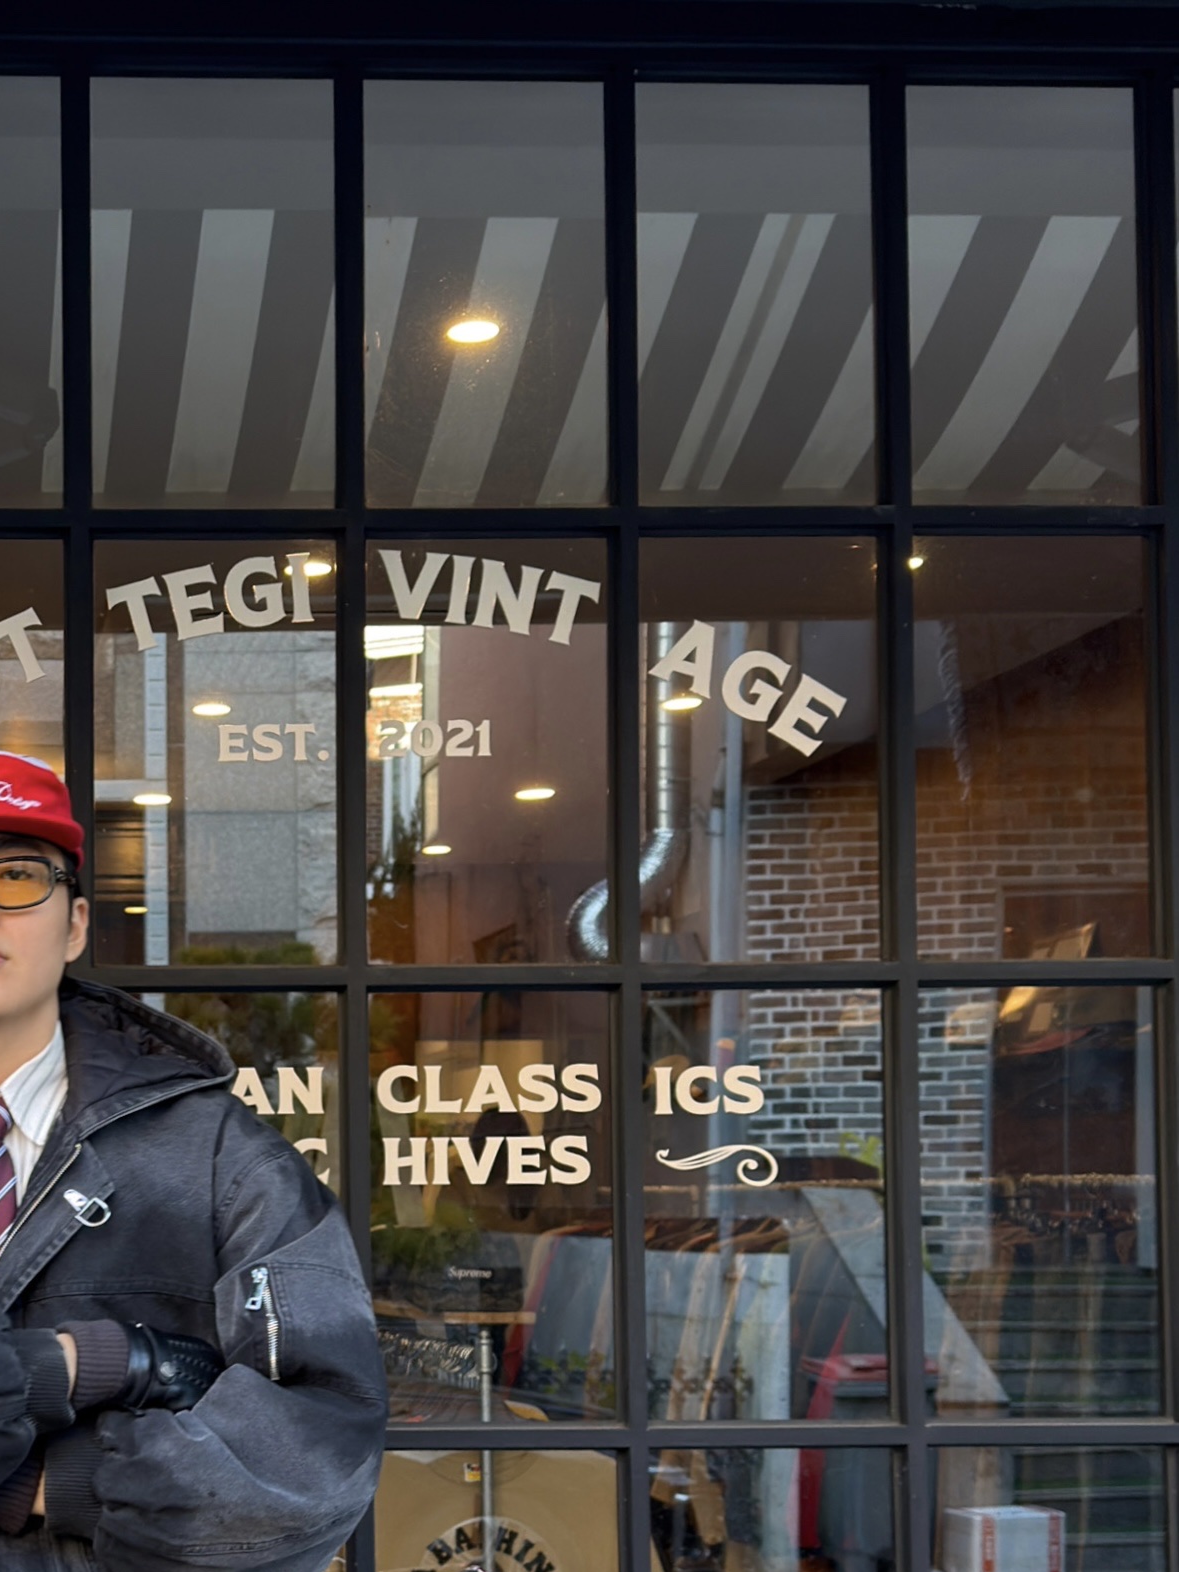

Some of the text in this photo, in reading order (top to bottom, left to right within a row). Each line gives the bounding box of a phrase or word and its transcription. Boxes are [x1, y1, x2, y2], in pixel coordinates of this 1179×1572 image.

[106, 552, 315, 651] TEGI
[378, 549, 601, 645] VINT
[648, 619, 847, 757] AGE
[218, 718, 492, 762] EST. 2021
[376, 1064, 602, 1115] CLASS
[653, 1065, 765, 1115] ICS
[382, 1136, 591, 1186] HIVES
